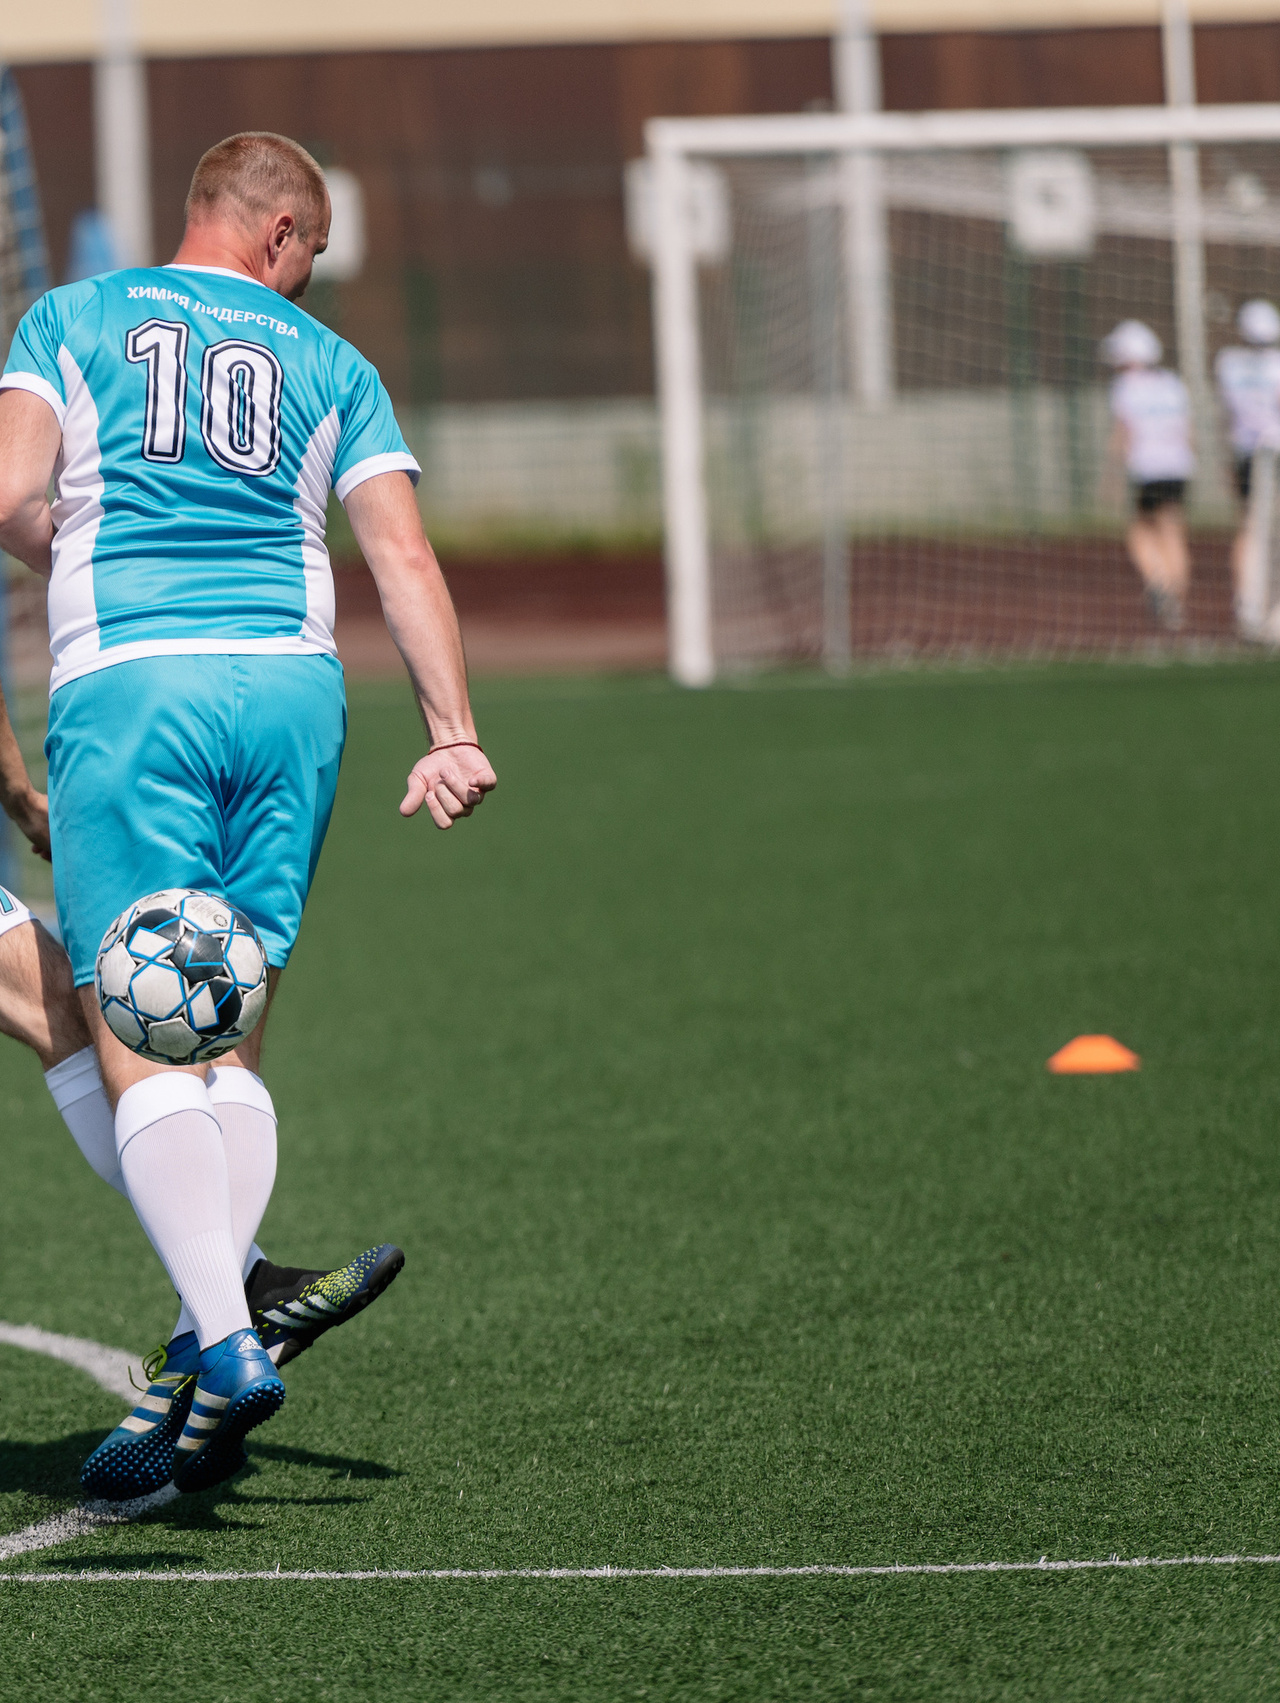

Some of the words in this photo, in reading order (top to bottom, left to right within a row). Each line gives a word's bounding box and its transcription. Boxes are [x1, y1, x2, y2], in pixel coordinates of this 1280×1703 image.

[127, 286, 190, 310] ХИМИЯ
[192, 300, 299, 339] ЛИДЕРСТВА
[125, 317, 284, 477] 10
